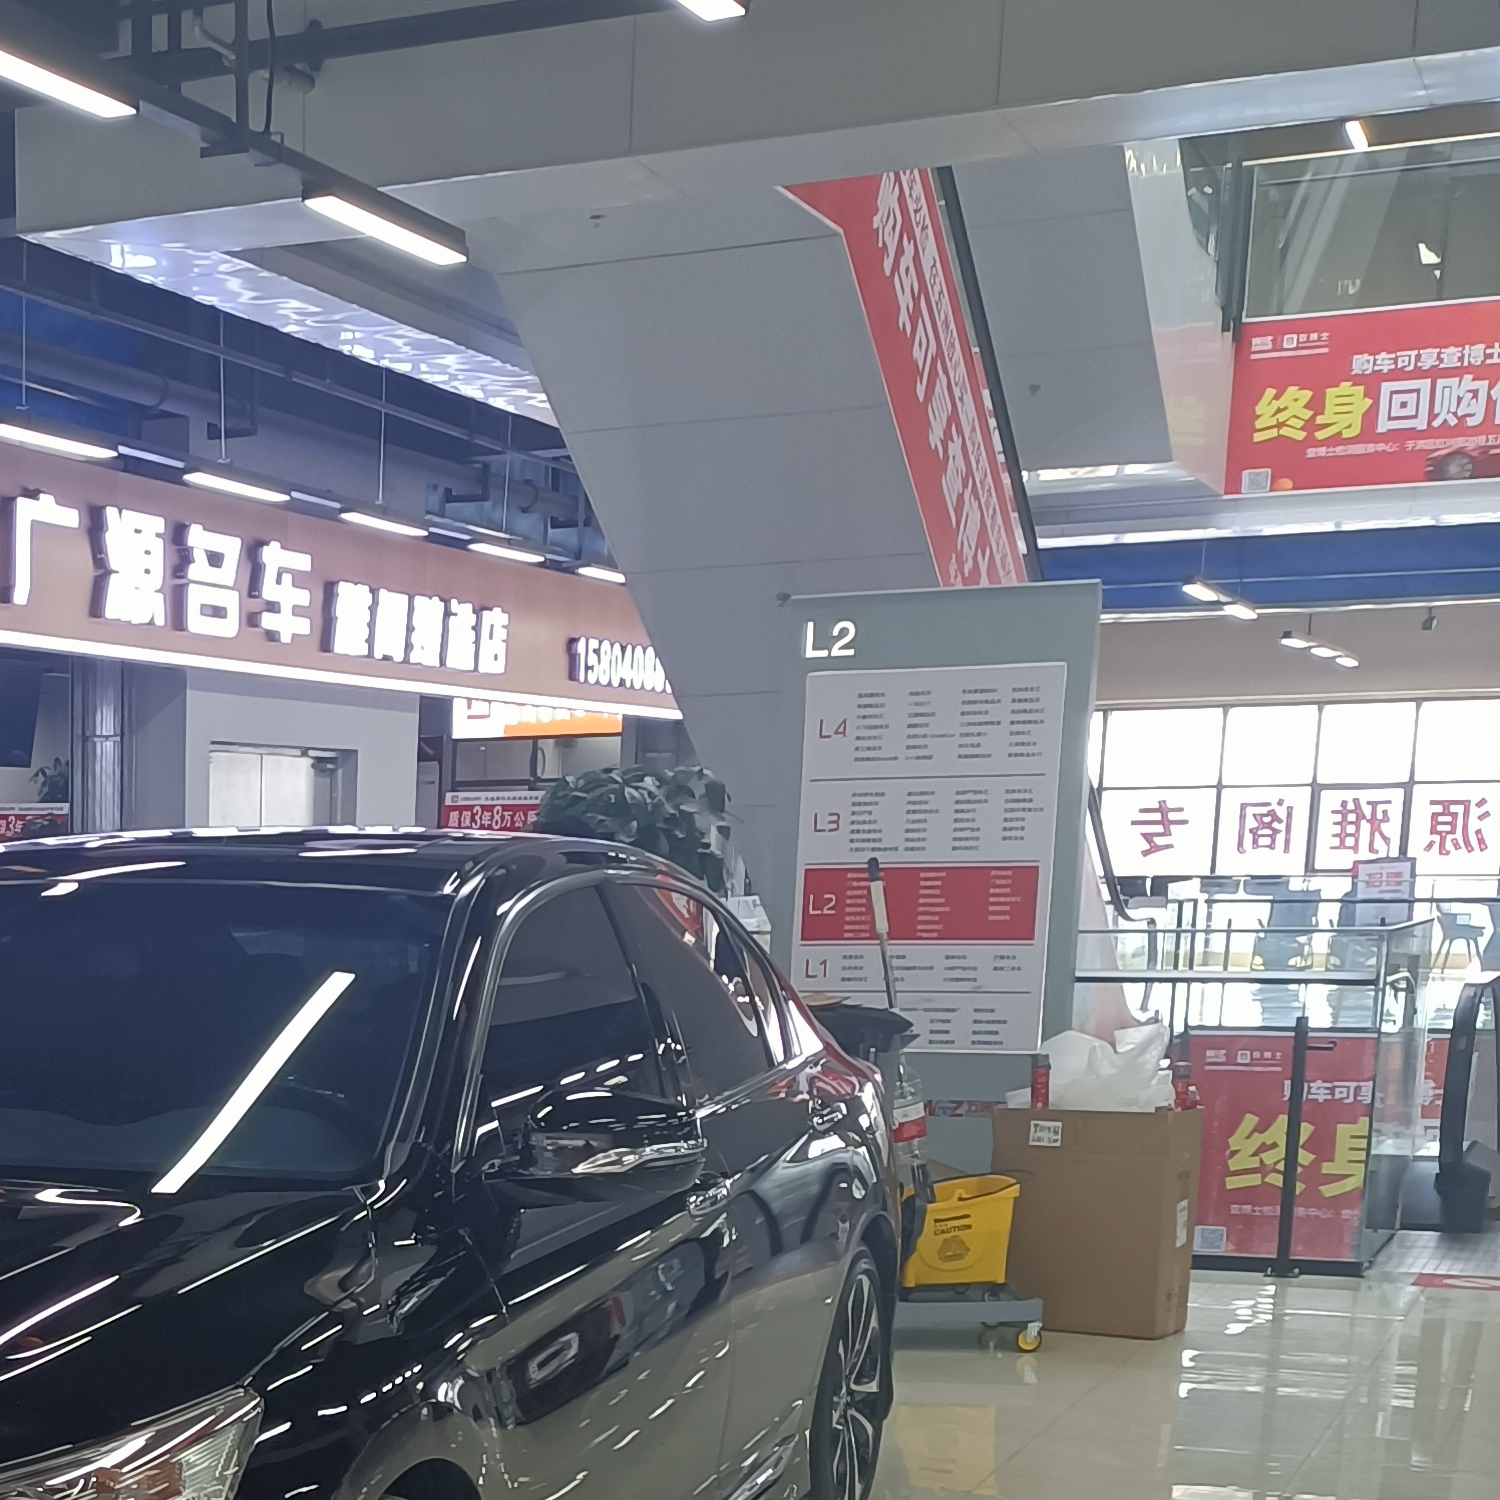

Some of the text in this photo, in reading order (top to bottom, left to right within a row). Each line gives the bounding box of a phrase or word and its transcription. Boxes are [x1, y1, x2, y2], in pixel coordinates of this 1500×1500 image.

[11, 490, 312, 644] 广源名车
[804, 620, 856, 659] L2
[577, 636, 673, 694] 1580408
[819, 717, 848, 739] L4
[813, 812, 841, 833] L3
[808, 893, 837, 915] L2
[805, 958, 828, 979] L1
[1225, 1112, 1370, 1198] 终身
